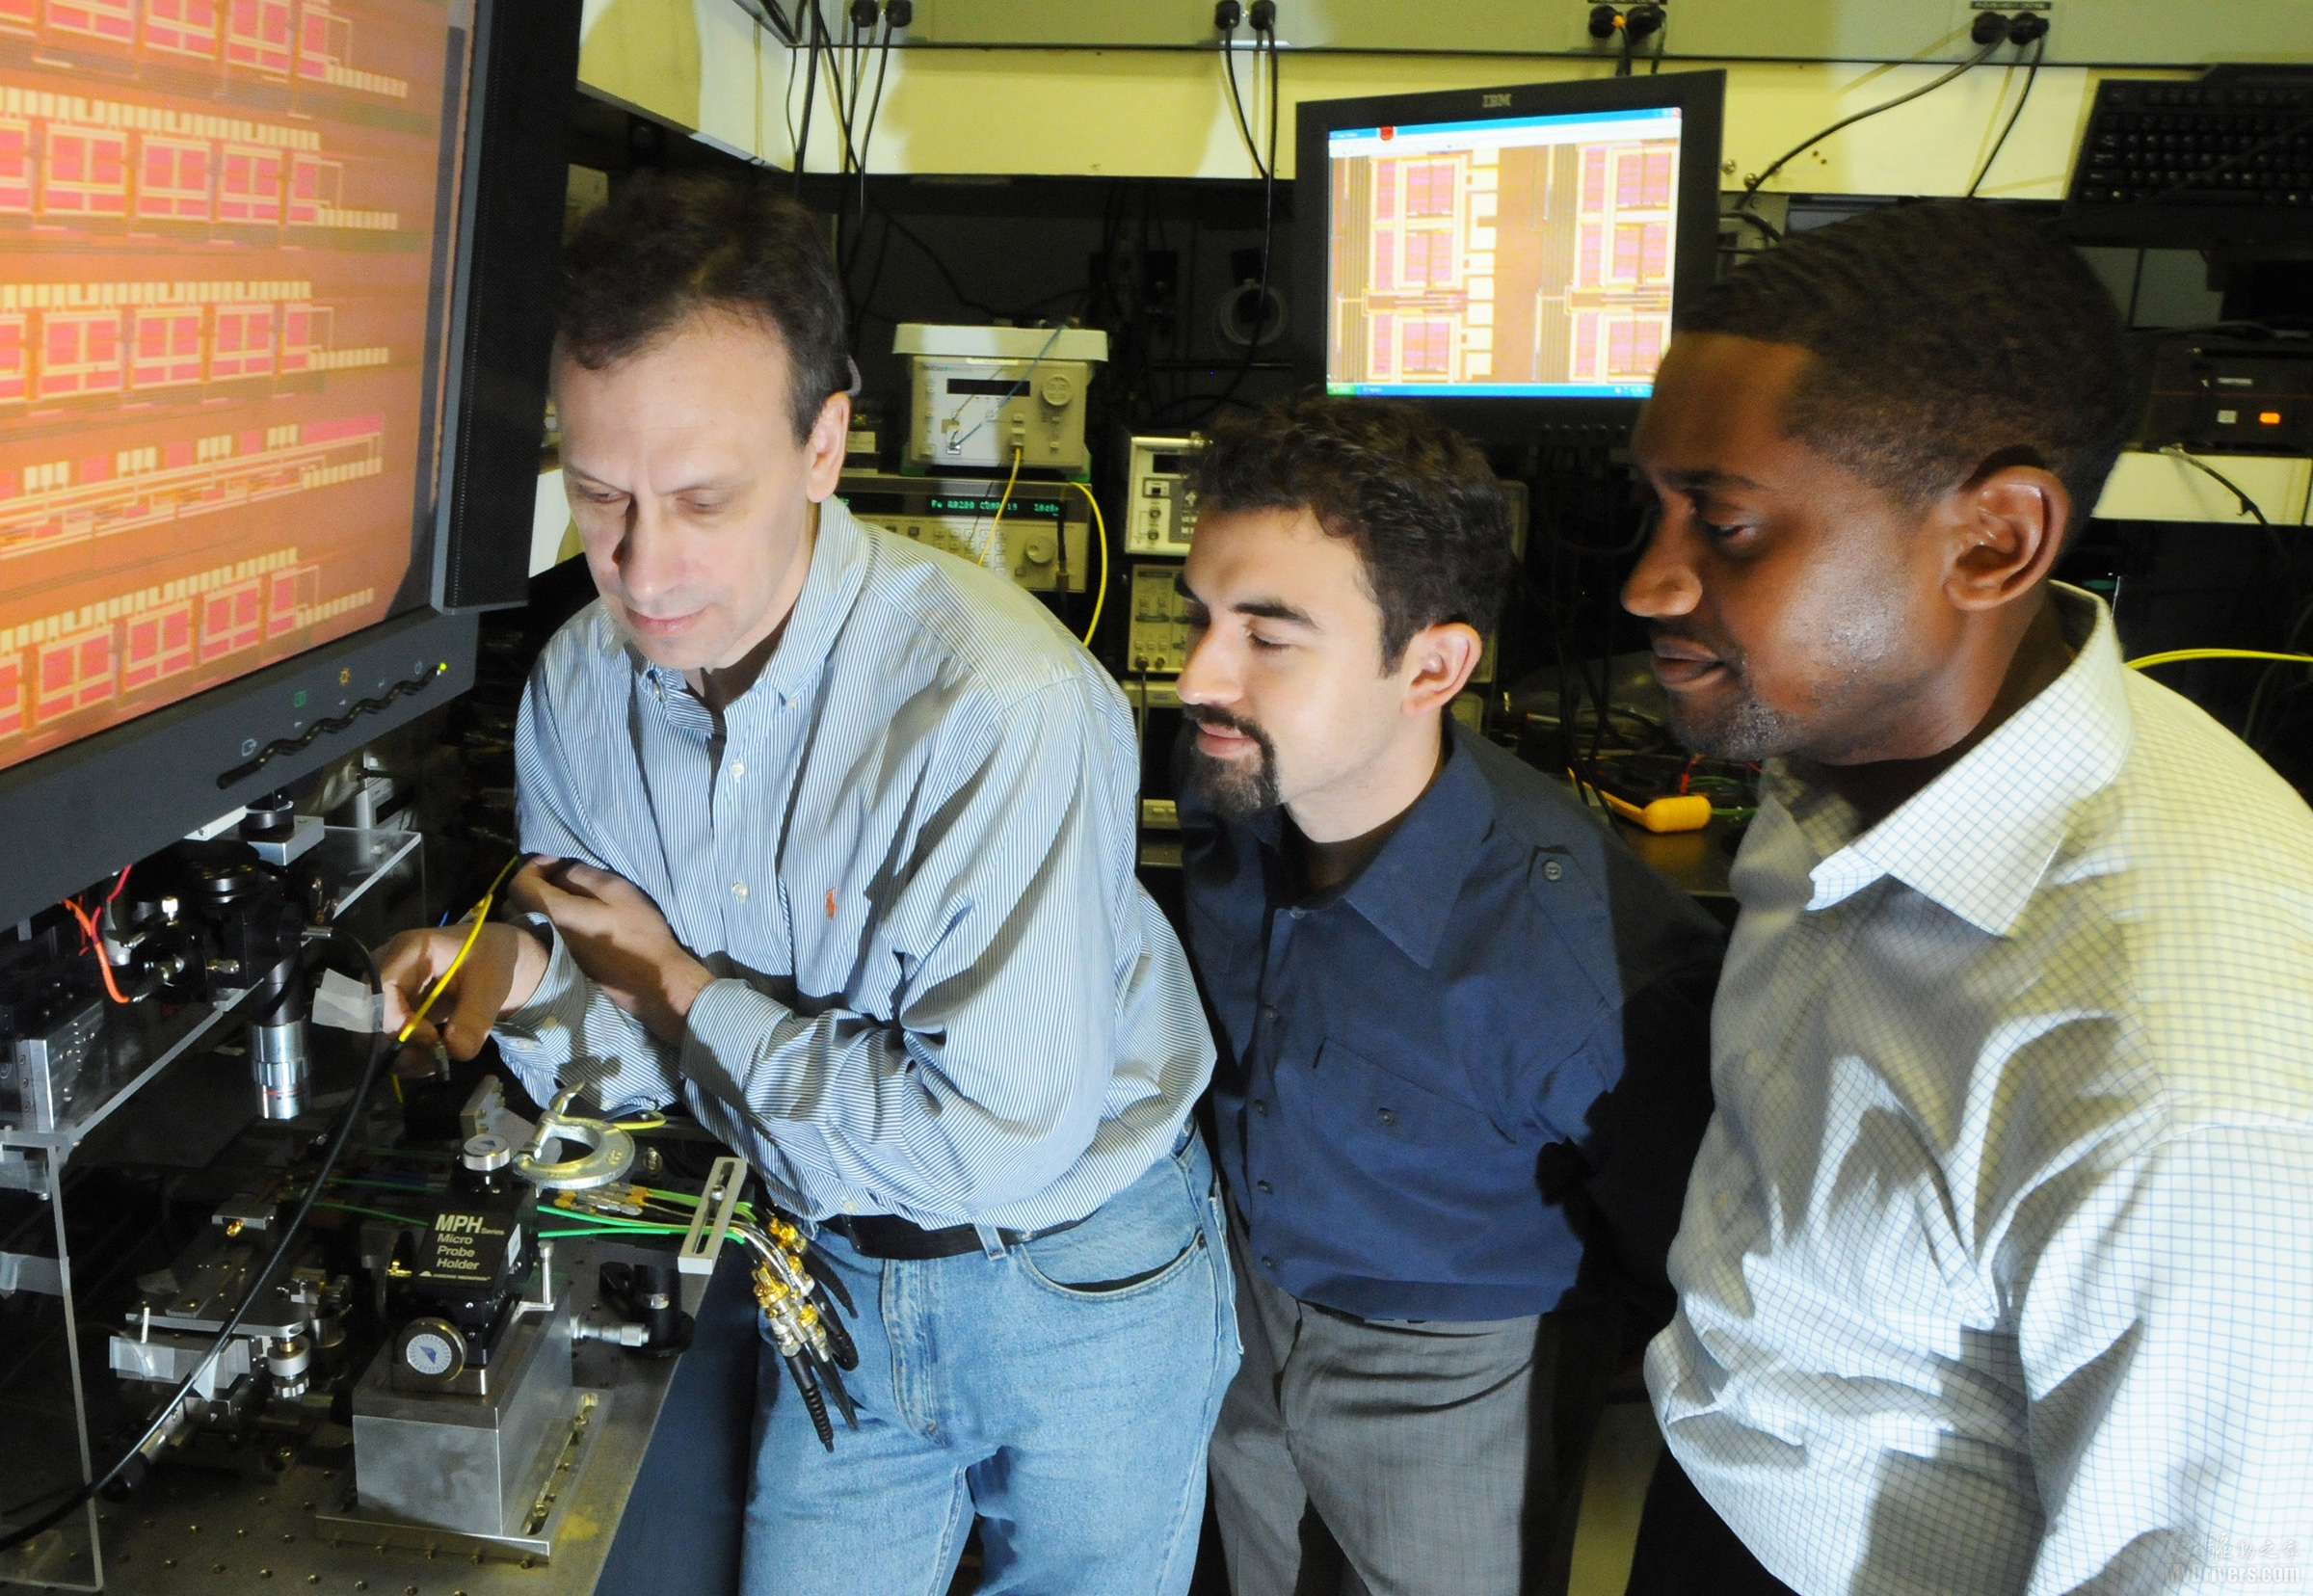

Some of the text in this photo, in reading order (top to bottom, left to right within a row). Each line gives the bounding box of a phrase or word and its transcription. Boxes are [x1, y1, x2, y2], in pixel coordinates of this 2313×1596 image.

[1483, 93, 1512, 107] IBM
[435, 1213, 484, 1234] MPH
[437, 1233, 473, 1245] Micro
[437, 1245, 475, 1257] Probe
[436, 1258, 480, 1269] Holder
